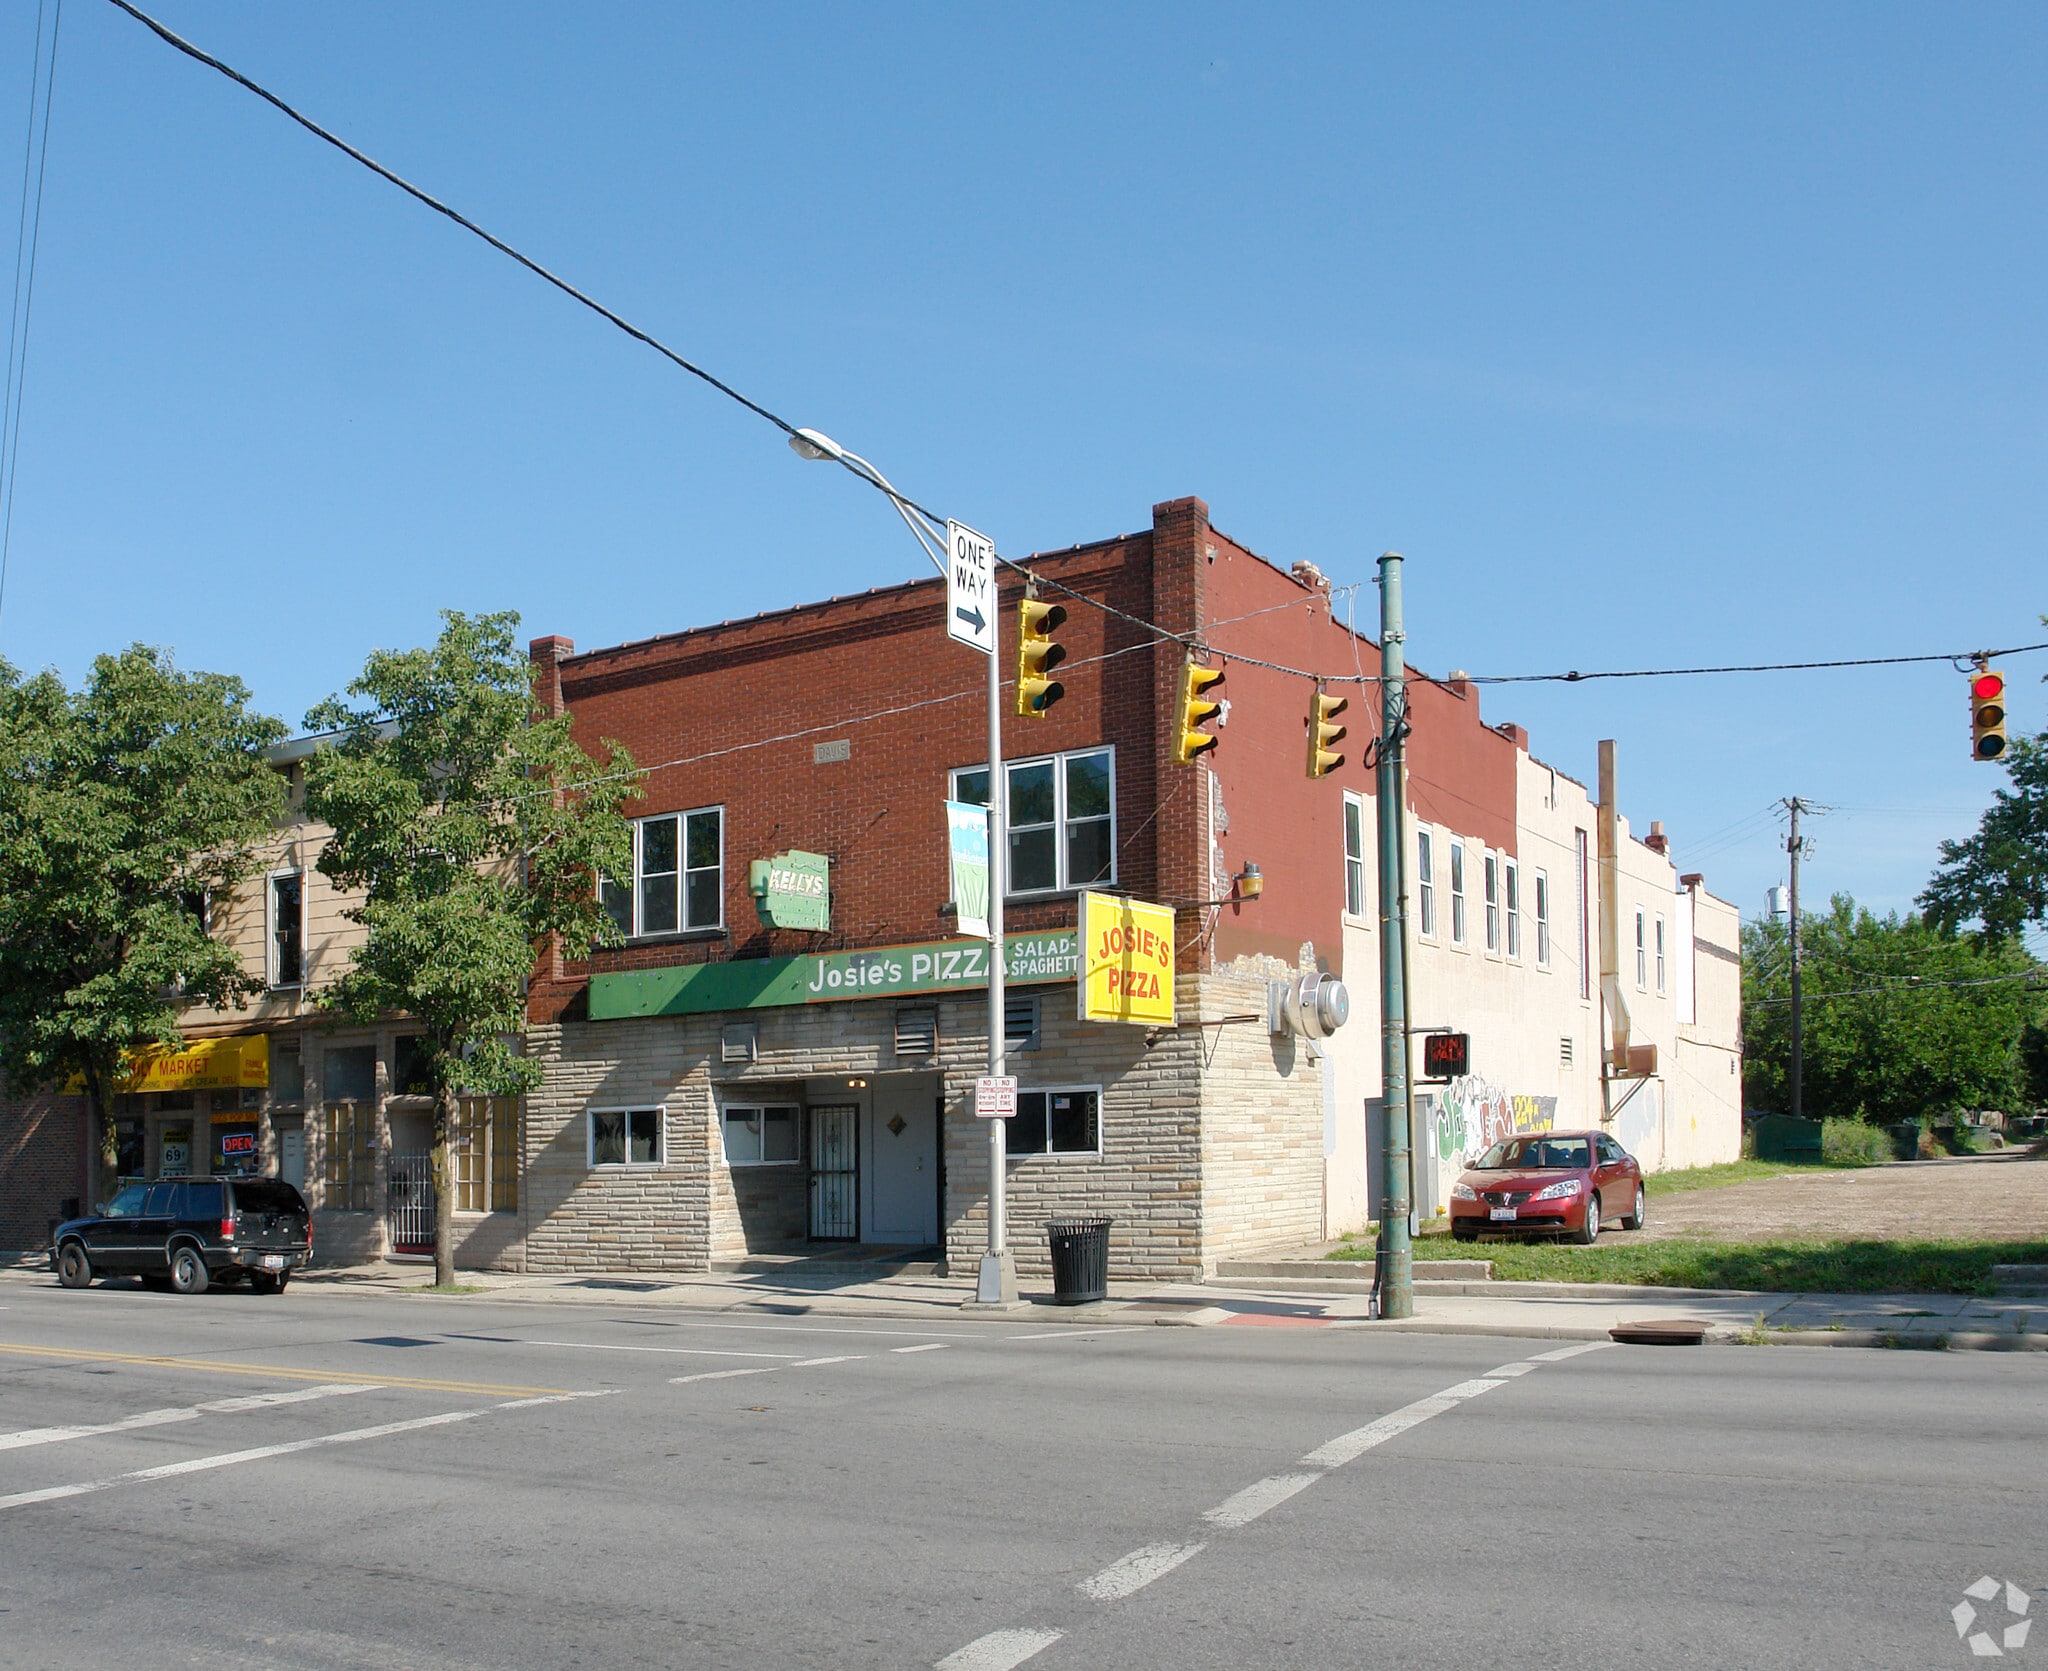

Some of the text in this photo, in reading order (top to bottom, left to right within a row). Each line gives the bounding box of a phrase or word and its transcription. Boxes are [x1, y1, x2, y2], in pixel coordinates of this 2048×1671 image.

[957, 535, 986, 570] ONE
[956, 564, 986, 600] WAY
[1099, 925, 1169, 968] JOSIE'S
[809, 959, 902, 991] Josie's
[1011, 955, 1079, 976] SPAGHETT
[1108, 967, 1160, 999] PIZZA
[160, 1057, 209, 1076] MARKET
[1087, 1094, 1097, 1145] OPEN
[224, 1137, 253, 1152] OPEN
